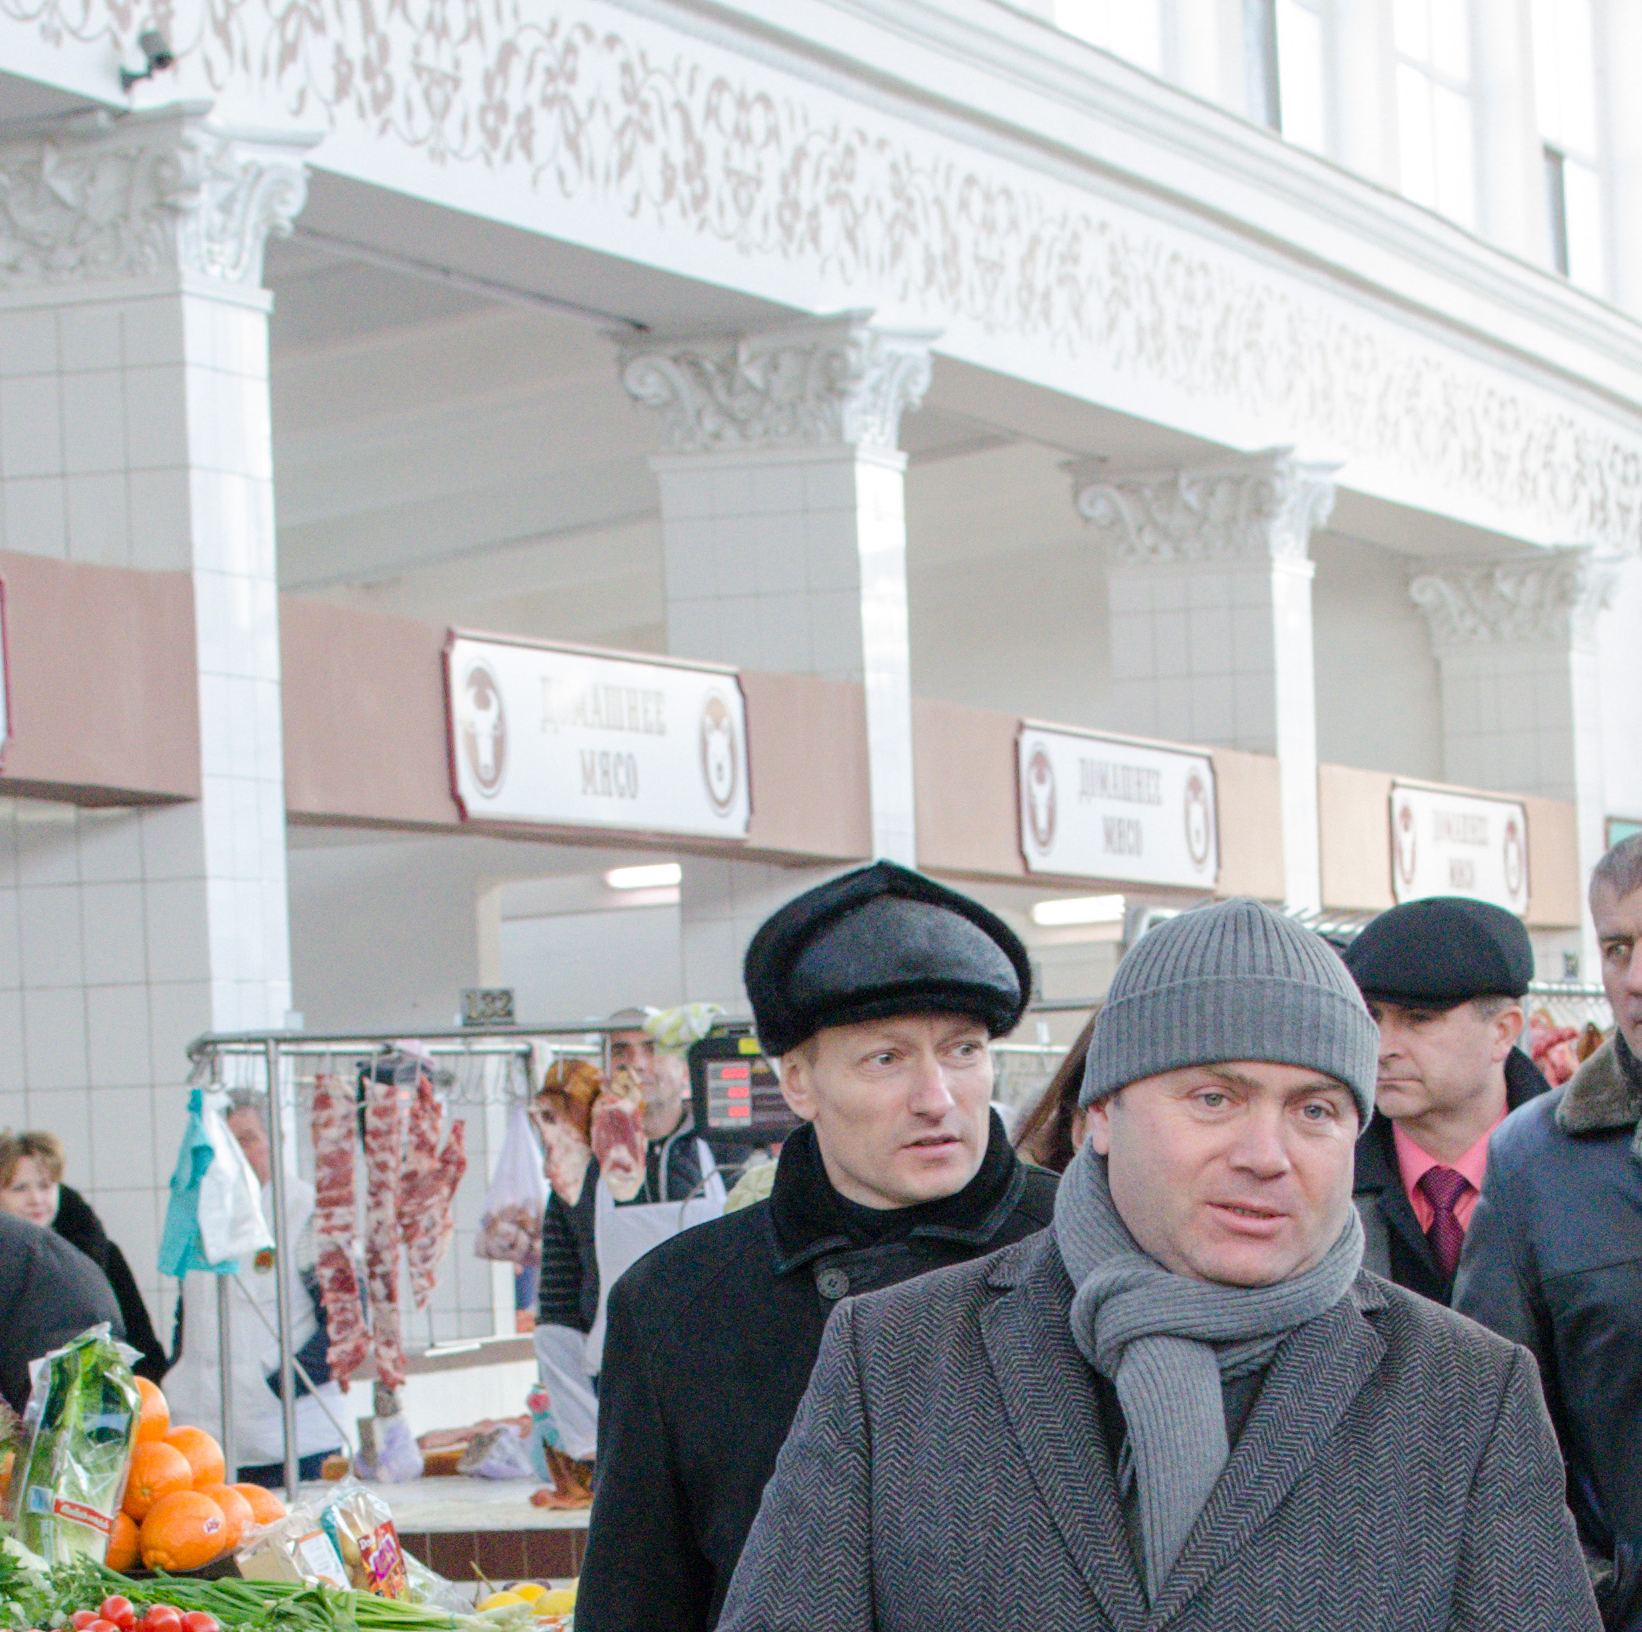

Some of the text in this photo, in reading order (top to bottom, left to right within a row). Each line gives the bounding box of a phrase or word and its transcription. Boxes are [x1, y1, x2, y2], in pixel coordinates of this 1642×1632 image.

[539, 675, 668, 736] ДМАШНЕЕ
[579, 749, 639, 801] МЯСО
[465, 990, 513, 1019] 132
